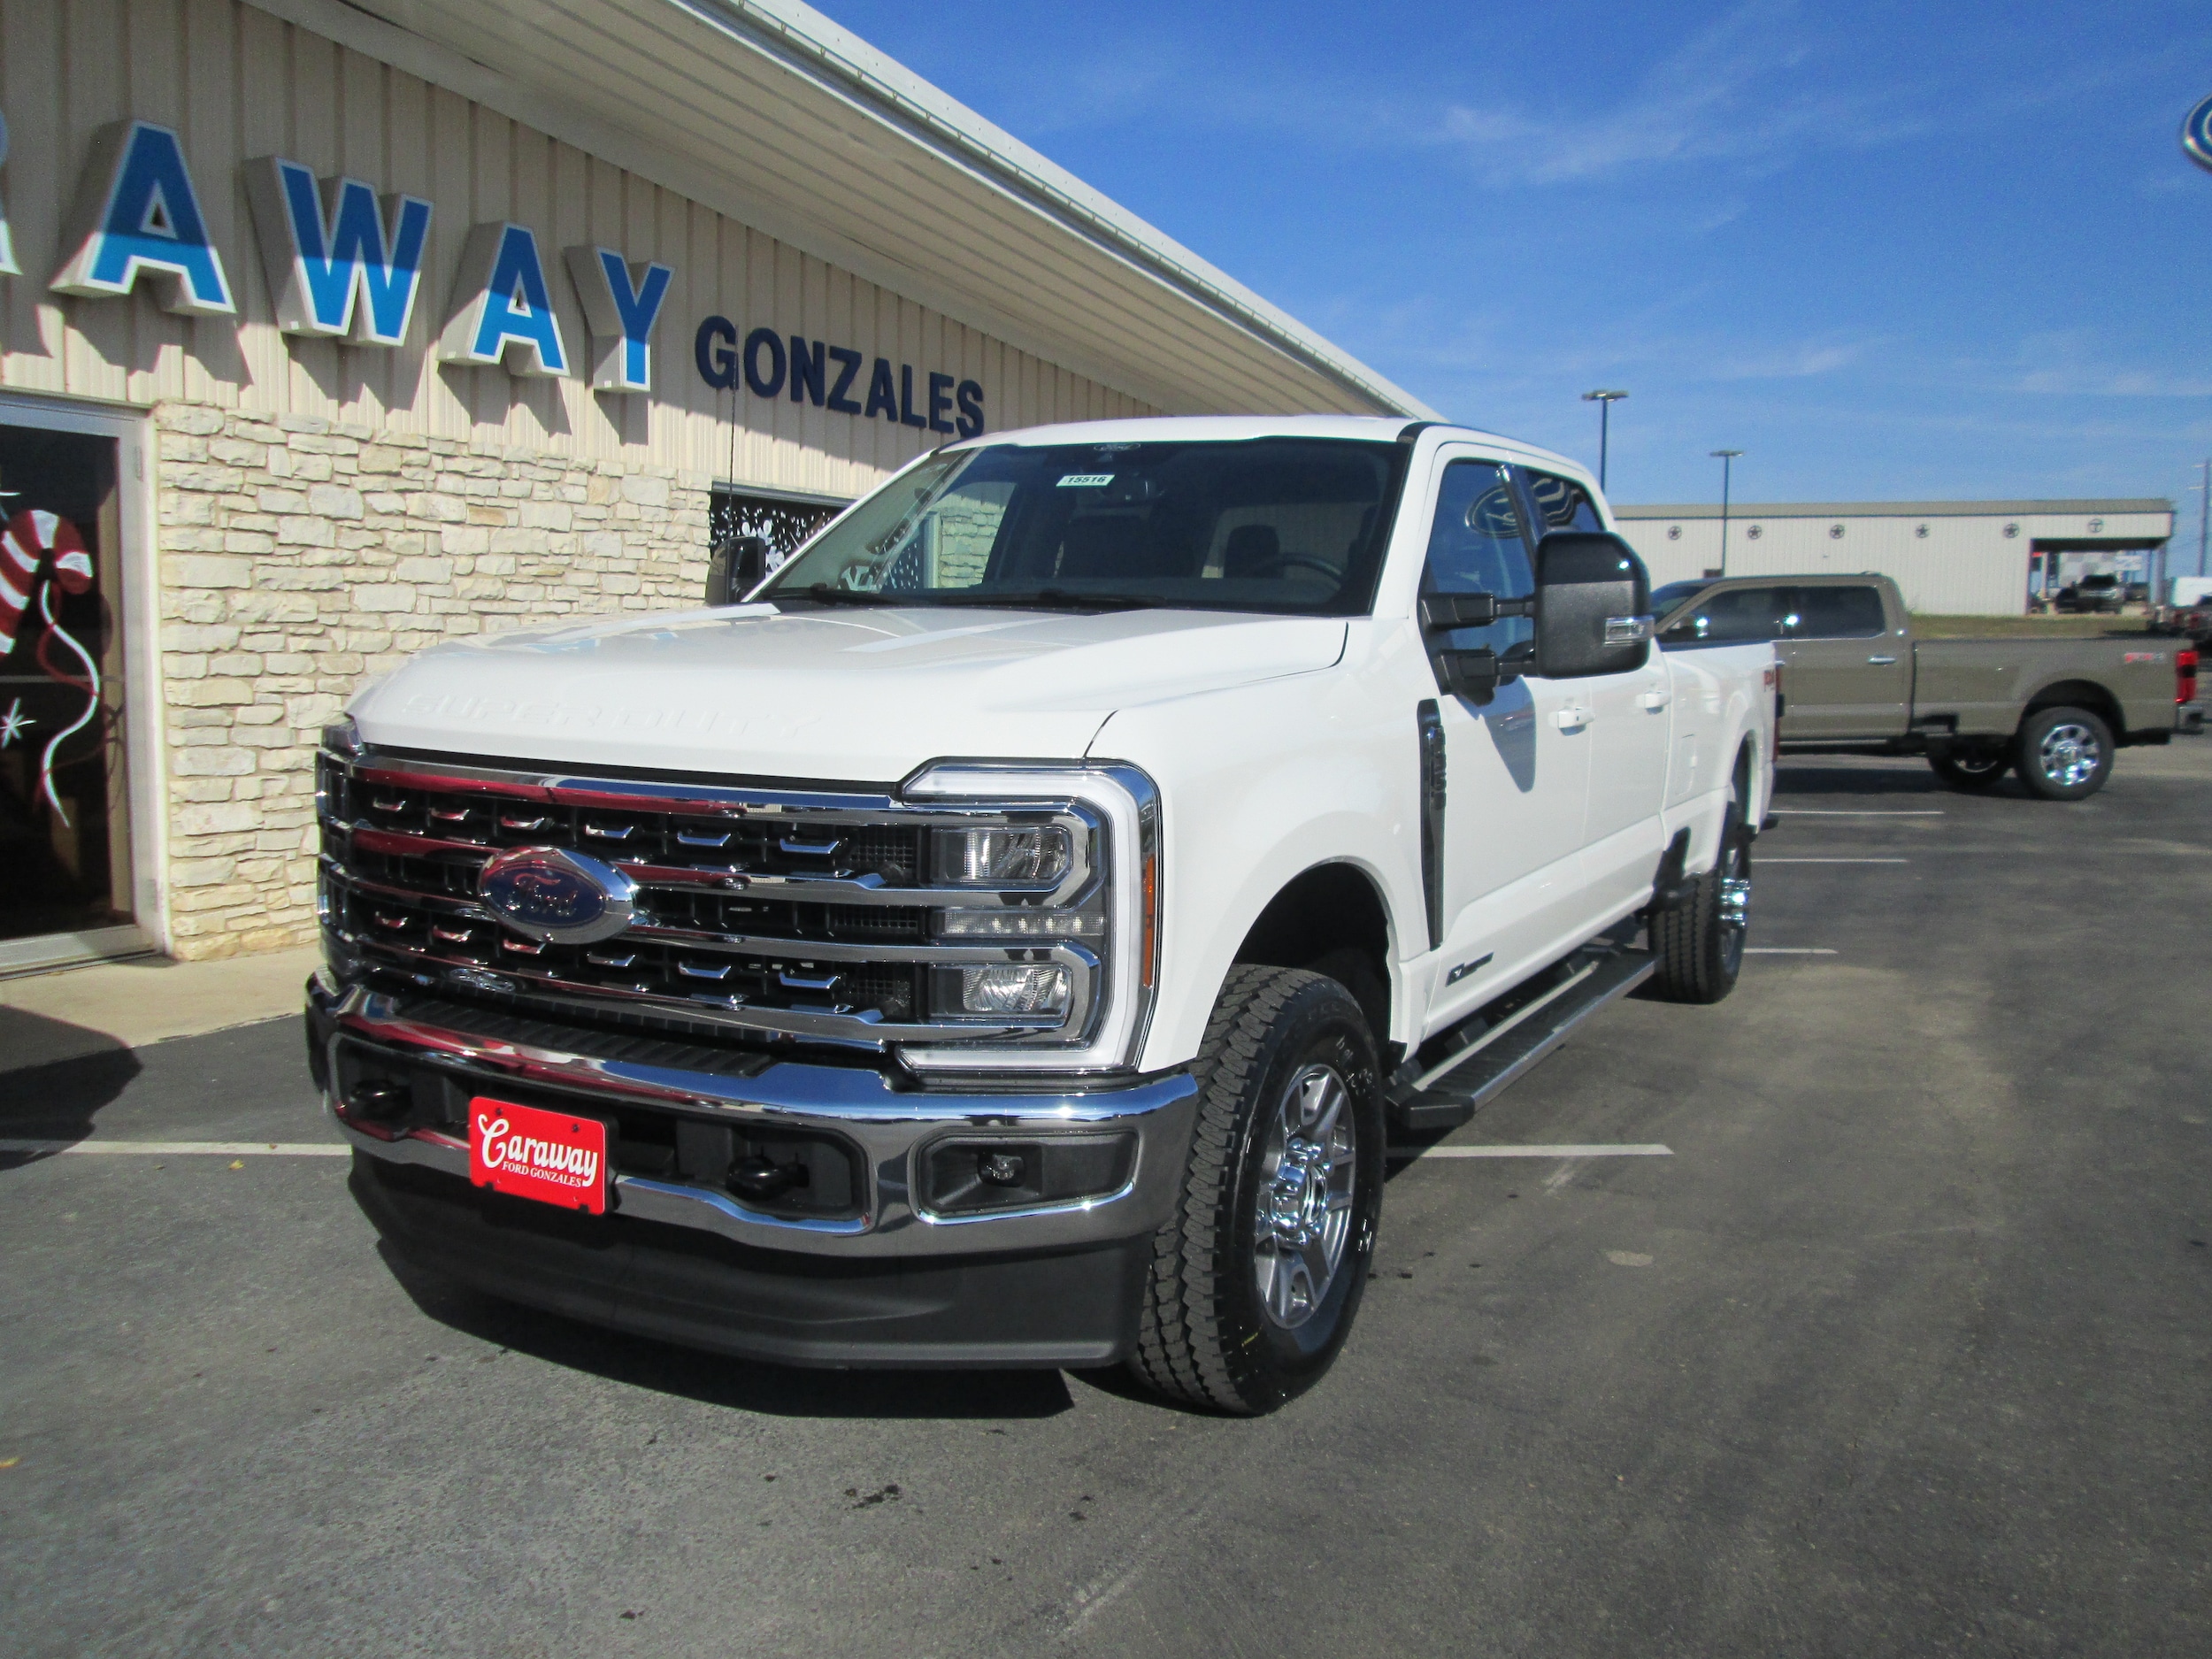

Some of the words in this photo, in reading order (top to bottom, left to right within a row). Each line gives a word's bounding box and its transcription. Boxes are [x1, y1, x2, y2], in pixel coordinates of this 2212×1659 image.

[0, 115, 674, 392] AWAY
[695, 315, 985, 438] GONZALES
[401, 693, 602, 728] SUPER
[611, 705, 822, 738] DUTY
[478, 1114, 598, 1188] Caraway
[502, 1161, 529, 1176] FORD
[530, 1167, 582, 1188] GONZALES
